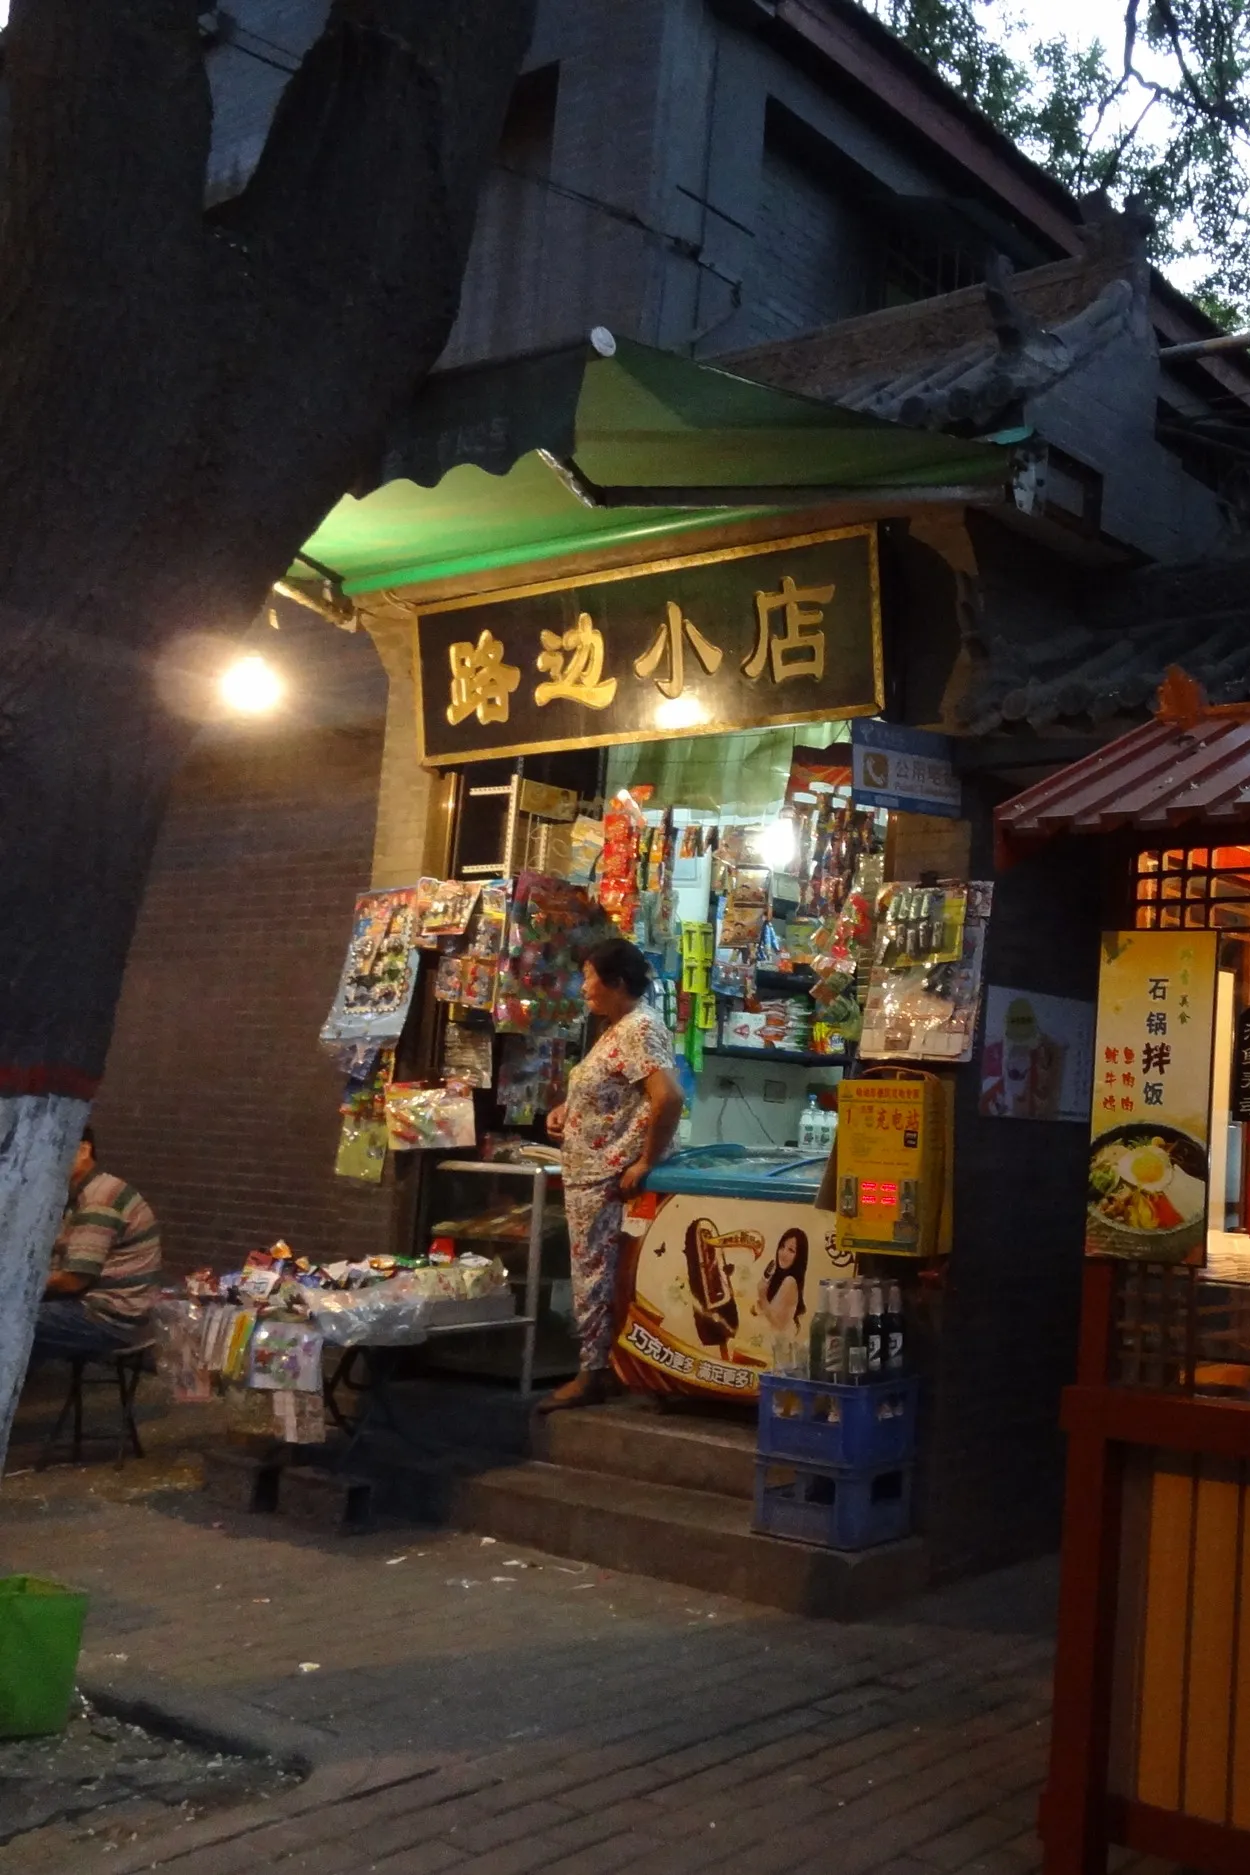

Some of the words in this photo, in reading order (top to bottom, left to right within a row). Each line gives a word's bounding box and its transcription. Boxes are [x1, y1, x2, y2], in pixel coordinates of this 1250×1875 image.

[446, 576, 835, 725] 路边小店
[1142, 978, 1171, 1106] 石锅拌饭
[876, 1109, 920, 1131] 充电站
[626, 1324, 695, 1374] 巧克力更多
[696, 1360, 755, 1388] 满足更多!
